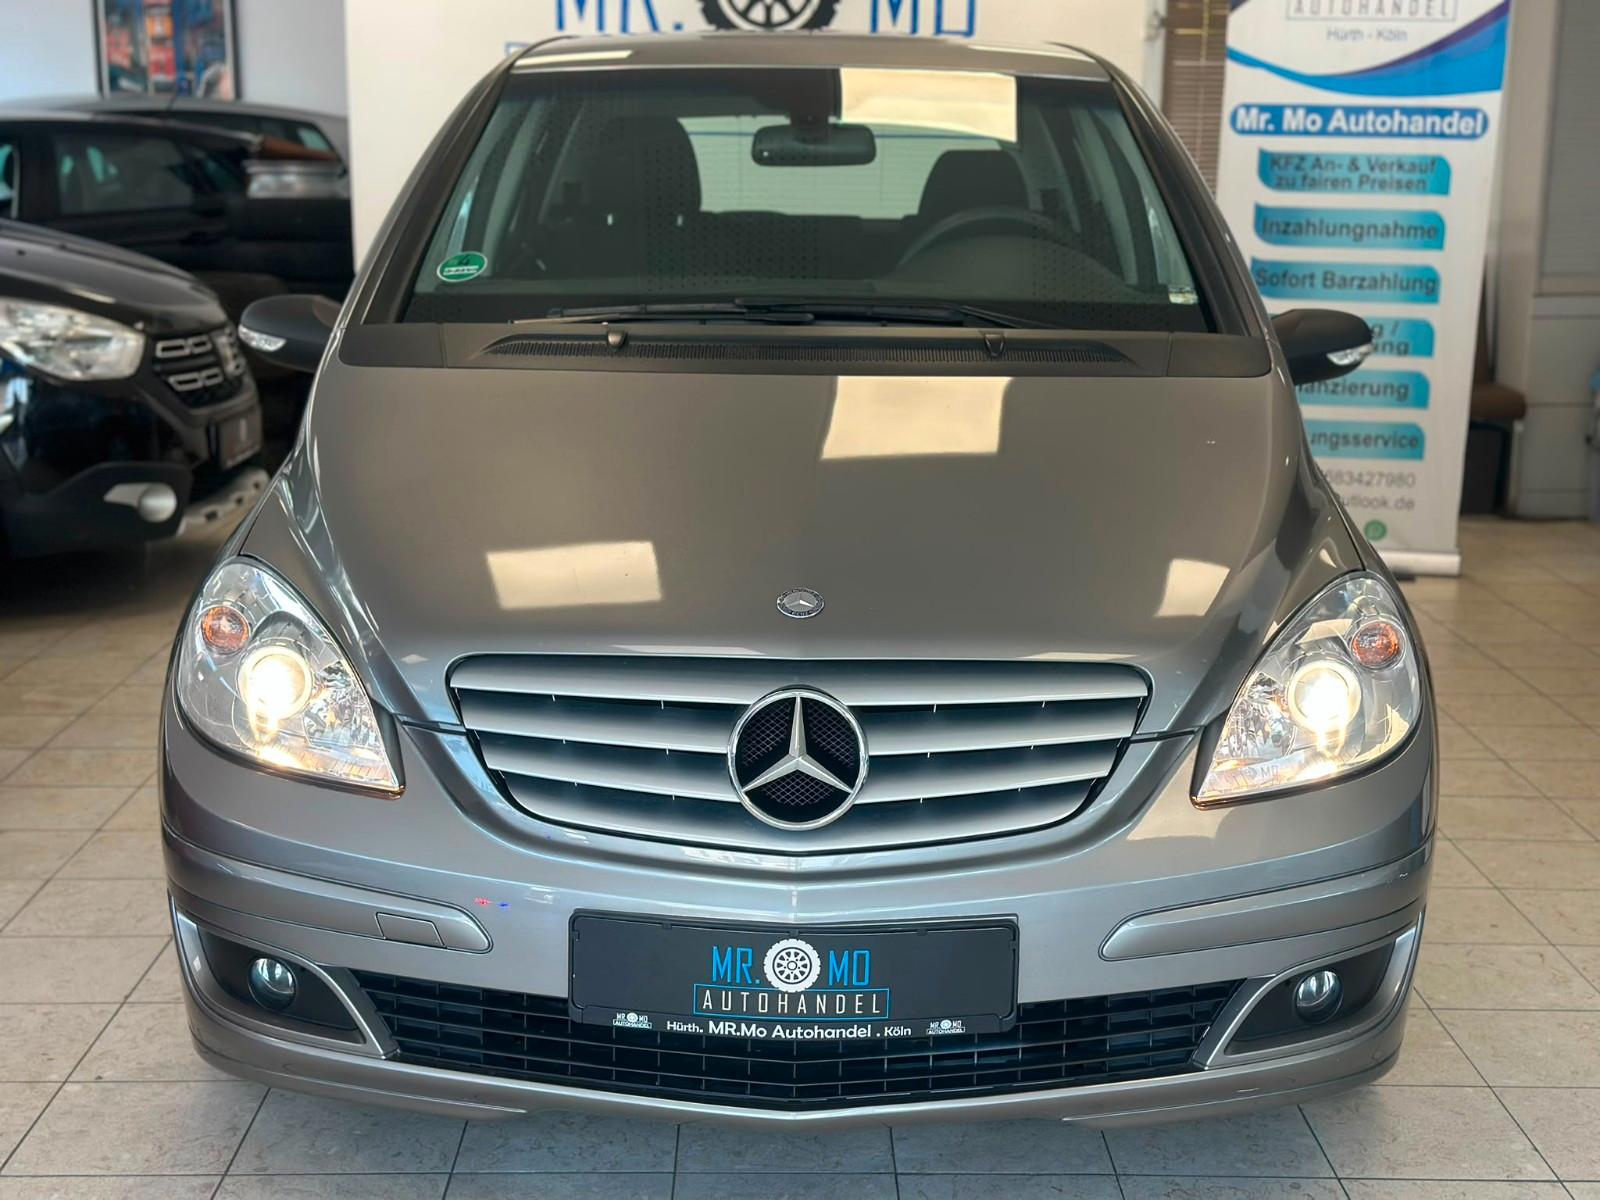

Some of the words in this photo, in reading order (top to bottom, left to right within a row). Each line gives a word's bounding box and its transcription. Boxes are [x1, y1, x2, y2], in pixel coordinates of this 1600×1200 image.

[1235, 107, 1275, 132] Mr.
[1282, 107, 1321, 132] Mo
[1327, 108, 1483, 135] Autohandel
[1269, 154, 1306, 171] KFZ
[1312, 156, 1343, 171] An-
[1347, 157, 1360, 171] &
[1367, 157, 1437, 174] Verkauf
[1275, 176, 1296, 189] zu
[1302, 173, 1351, 190] fairen
[1358, 175, 1428, 191] Preisen
[1262, 217, 1439, 242] Inzahlungnahme
[1255, 267, 1315, 288] Sofort
[1322, 270, 1437, 296] Barzahlung
[1299, 379, 1410, 403] anzierung
[711, 945, 762, 985] MR.
[827, 949, 871, 987] MO
[702, 989, 881, 1015] AUTOHANDEL
[708, 1020, 768, 1038] MR.Mo
[772, 1024, 872, 1040] Autohandel
[884, 1026, 912, 1037] Köln
